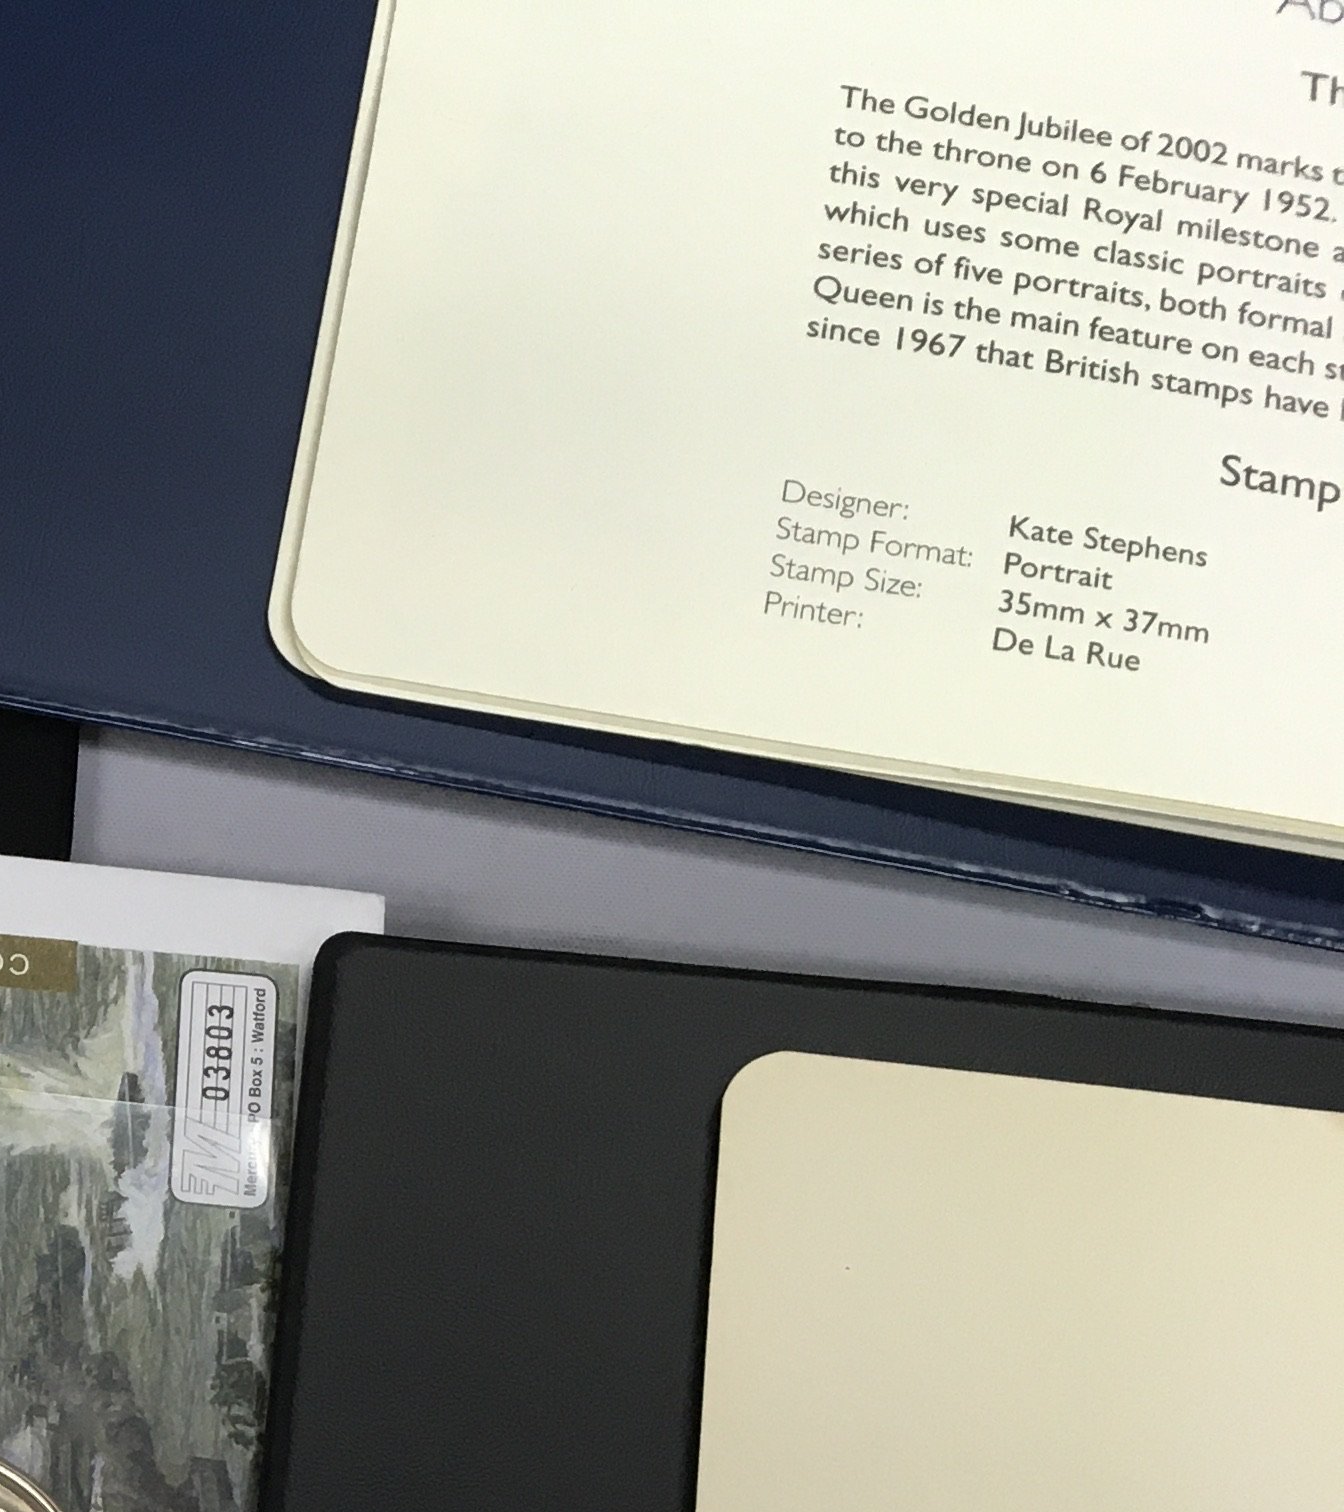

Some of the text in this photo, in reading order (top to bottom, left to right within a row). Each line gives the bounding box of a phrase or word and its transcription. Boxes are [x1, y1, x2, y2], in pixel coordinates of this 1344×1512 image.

[841, 85, 895, 116] The
[904, 95, 1010, 132] Golden
[1015, 111, 1112, 148] Jubilee
[1121, 130, 1152, 153] of
[1158, 134, 1228, 167] 2002
[1236, 151, 1324, 183] marks
[835, 126, 1339, 224] to the throne on 6 February 1952.
[829, 163, 1320, 260] this very special Royal milestone
[824, 201, 1327, 302] which uses some classic portraits
[818, 241, 1332, 341] series of five portraits, both formal
[813, 275, 1316, 379] Queen is the main feature on each
[805, 318, 881, 349] since
[894, 327, 967, 359] 1967
[975, 340, 1035, 372] that
[1045, 349, 1140, 388] British
[1150, 371, 1254, 409] stamps
[1263, 385, 1330, 420] have
[781, 479, 910, 521] Designer:
[1220, 454, 1341, 513] Stamp
[776, 516, 973, 569] Stamp Format:
[1008, 514, 1208, 568] Kate Stephens
[770, 554, 923, 599] Stamp Size:
[1004, 552, 1113, 592] Portrait
[764, 591, 864, 630] Printer:
[997, 590, 1210, 645] 35mm x 37mm
[992, 627, 1141, 672] De La Rue
[251, 988, 266, 1044] Watford
[201, 1004, 234, 1102] 03803
[250, 1056, 263, 1066] 5
[249, 1066, 262, 1098] Box
